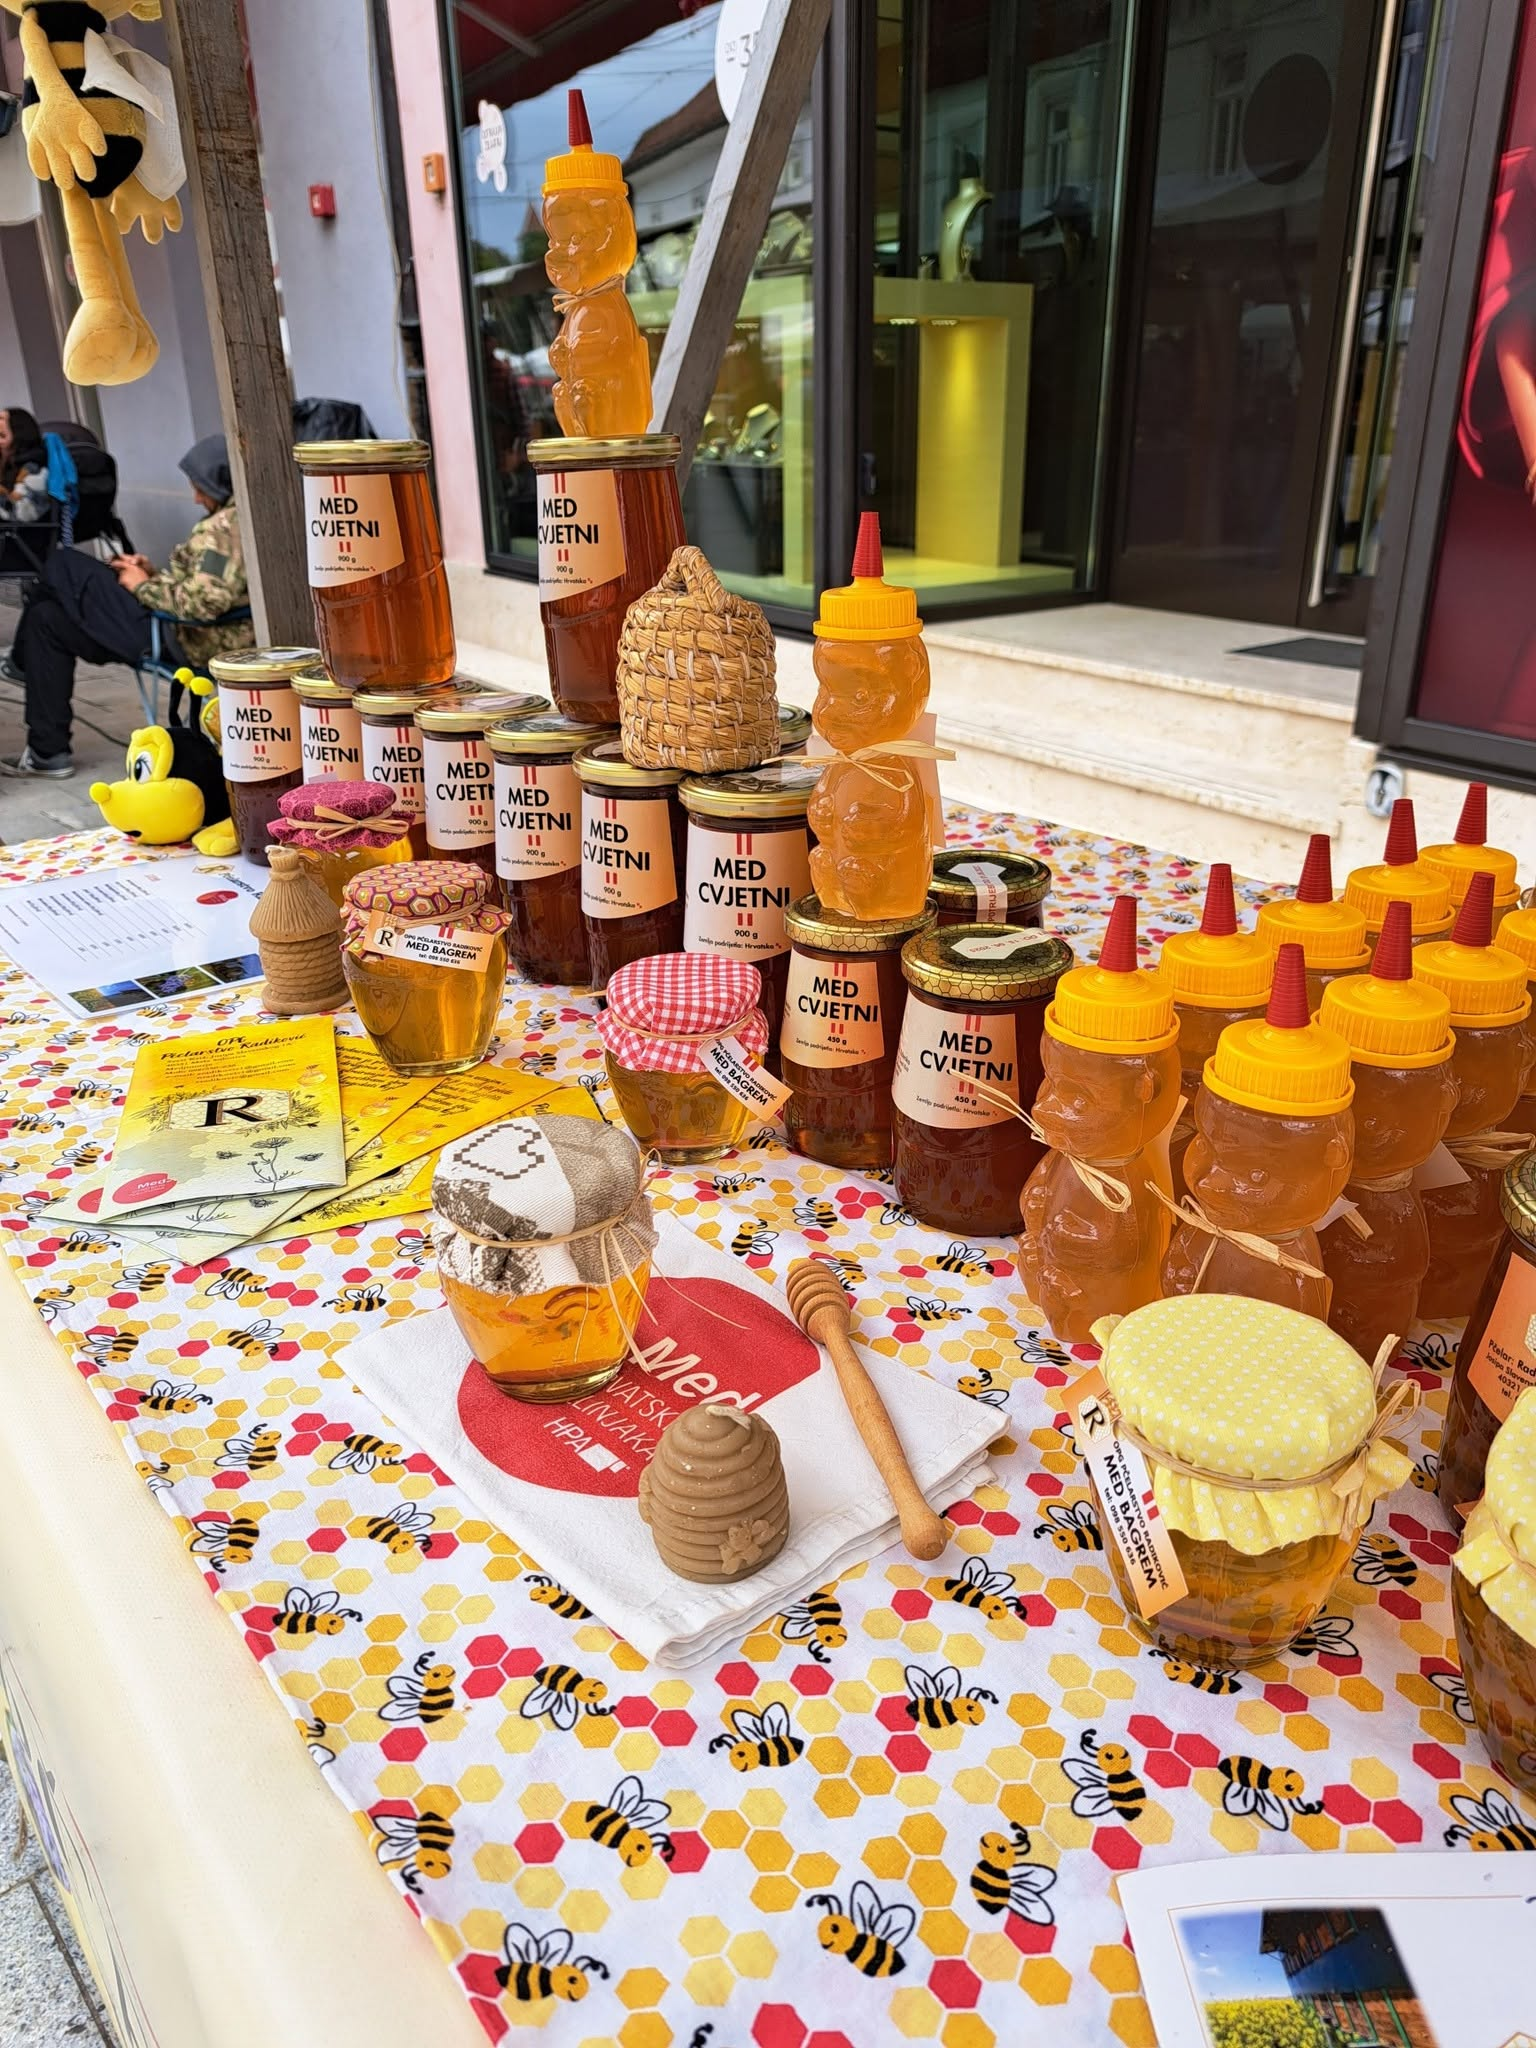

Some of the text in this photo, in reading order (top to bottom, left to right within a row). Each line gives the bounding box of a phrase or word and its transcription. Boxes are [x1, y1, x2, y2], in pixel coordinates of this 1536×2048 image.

[319, 497, 358, 515] MED
[542, 498, 577, 518] MED
[311, 520, 380, 538] CVJETNI
[236, 707, 272, 723] MED
[227, 726, 292, 742] CVJETNI
[308, 726, 340, 742] MED
[303, 744, 359, 763] CVJETNI
[382, 746, 422, 762] MED
[372, 766, 424, 784] CVJET
[448, 762, 490, 780] MED
[436, 784, 494, 801] CVJET
[508, 786, 550, 807] MED
[500, 809, 572, 831] CVJETNI
[590, 818, 628, 844] MED
[526, 848, 539, 856] 900
[582, 840, 650, 872] CVJETNI
[714, 857, 766, 880] MED
[603, 886, 615, 894] 900
[698, 882, 790, 908] CVJETNI
[378, 930, 394, 948] R
[406, 940, 476, 960] MED BAGREM
[813, 976, 858, 998] MED
[798, 995, 878, 1022] CVJETNI
[939, 1030, 992, 1055] MED
[920, 1050, 1013, 1081] CVJETNI
[710, 1048, 768, 1106] MED BAGREM
[954, 1096, 970, 1104] 450
[194, 1095, 272, 1128] R
[1486, 1352, 1504, 1370] Josipa
[1488, 1339, 1514, 1366] Pčelar:
[1498, 1374, 1520, 1392] 40321
[605, 1375, 679, 1430] VATSK
[567, 1395, 656, 1461] LINJAKA
[1081, 1402, 1104, 1438] R
[544, 1416, 592, 1453] HPA
[1104, 1454, 1158, 1589] MED BAGREM
[1113, 1441, 1169, 1590] OPG PČELARSTVO RADIKOVIĆ
[1104, 1487, 1136, 1566] tel: 098 550 636
